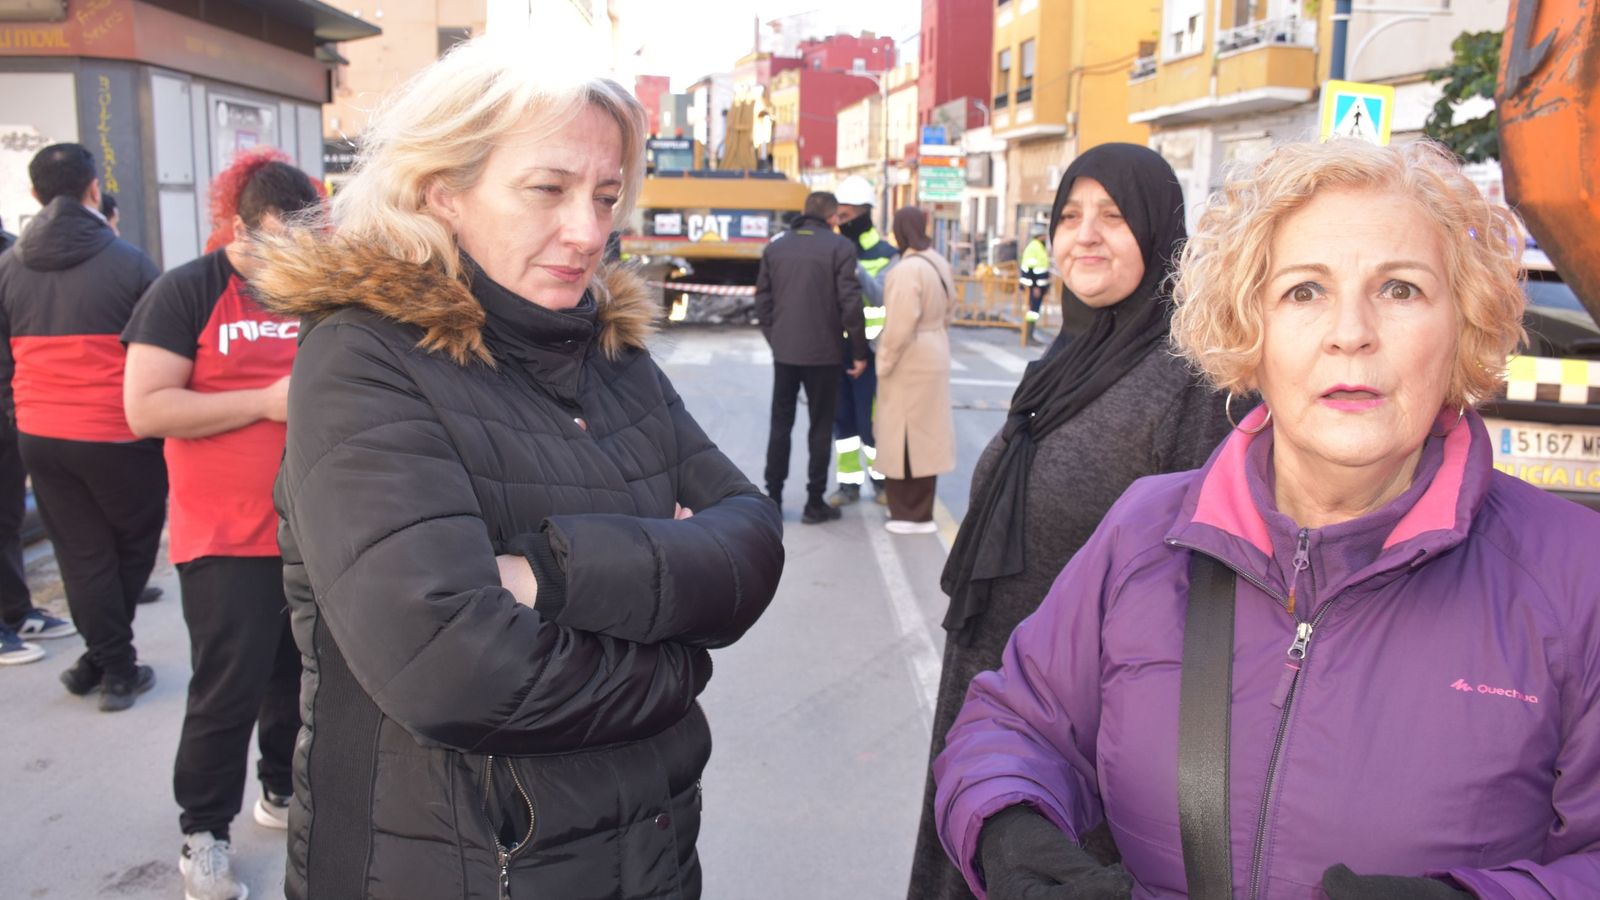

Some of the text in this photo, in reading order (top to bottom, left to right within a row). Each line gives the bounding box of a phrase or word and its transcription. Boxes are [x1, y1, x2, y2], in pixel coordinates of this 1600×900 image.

[687, 214, 732, 241] CAT
[1518, 432, 1573, 454] 5167
[1477, 684, 1538, 703] Quechua
